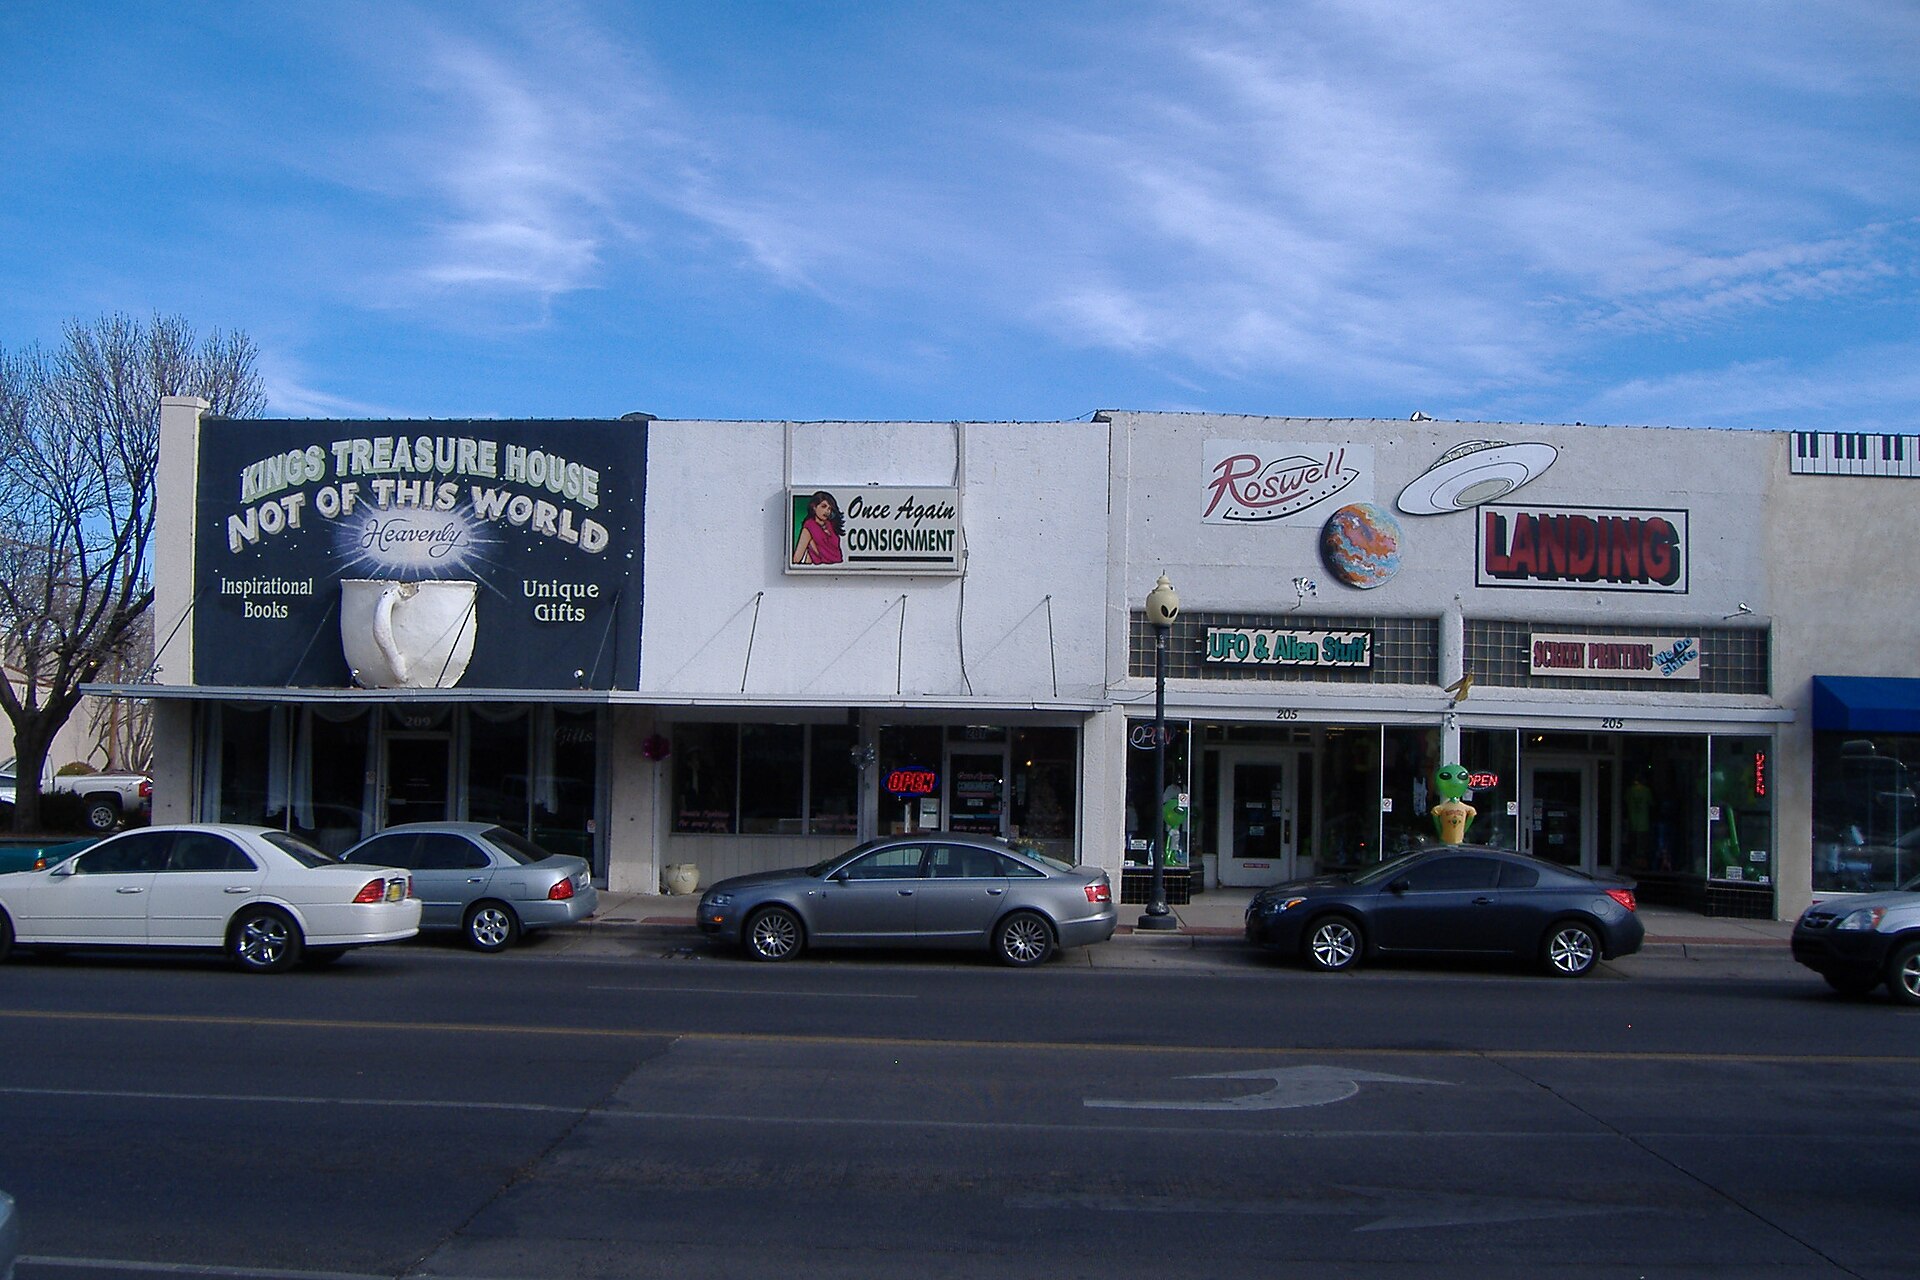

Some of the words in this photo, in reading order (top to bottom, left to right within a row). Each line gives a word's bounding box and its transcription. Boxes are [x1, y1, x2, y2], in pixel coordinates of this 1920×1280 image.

[240, 445, 325, 504] KINGS
[331, 436, 497, 478] TREASURE
[506, 444, 600, 508] HOUSE
[1203, 448, 1345, 518] Roswell
[228, 492, 305, 554] NOT
[316, 482, 360, 519] OF
[372, 479, 457, 511] THIS
[471, 486, 610, 554] WORLD
[847, 495, 890, 519] Once
[894, 495, 955, 528] Again
[360, 518, 468, 558] Heavenly
[847, 528, 955, 552] CONSIGNMENT
[1485, 511, 1680, 586] LANDING
[220, 577, 314, 599] Inspirational
[523, 579, 599, 601] Unique
[244, 600, 288, 619] Books
[534, 602, 586, 623] Gifts
[1210, 632, 1250, 658] UFO
[1254, 634, 1270, 660] &
[1273, 635, 1319, 661] Alien
[1322, 636, 1367, 663] Stuff
[1533, 641, 1585, 669] SCREEN
[1588, 643, 1653, 671] PRINTING
[1653, 650, 1675, 667] We
[1673, 637, 1693, 653] Do
[1660, 649, 1699, 677] Shirts
[405, 716, 431, 727] 209
[1277, 708, 1298, 720] 205
[1602, 718, 1624, 730] 205
[554, 725, 594, 747] Gifts
[888, 771, 935, 792] OPEN
